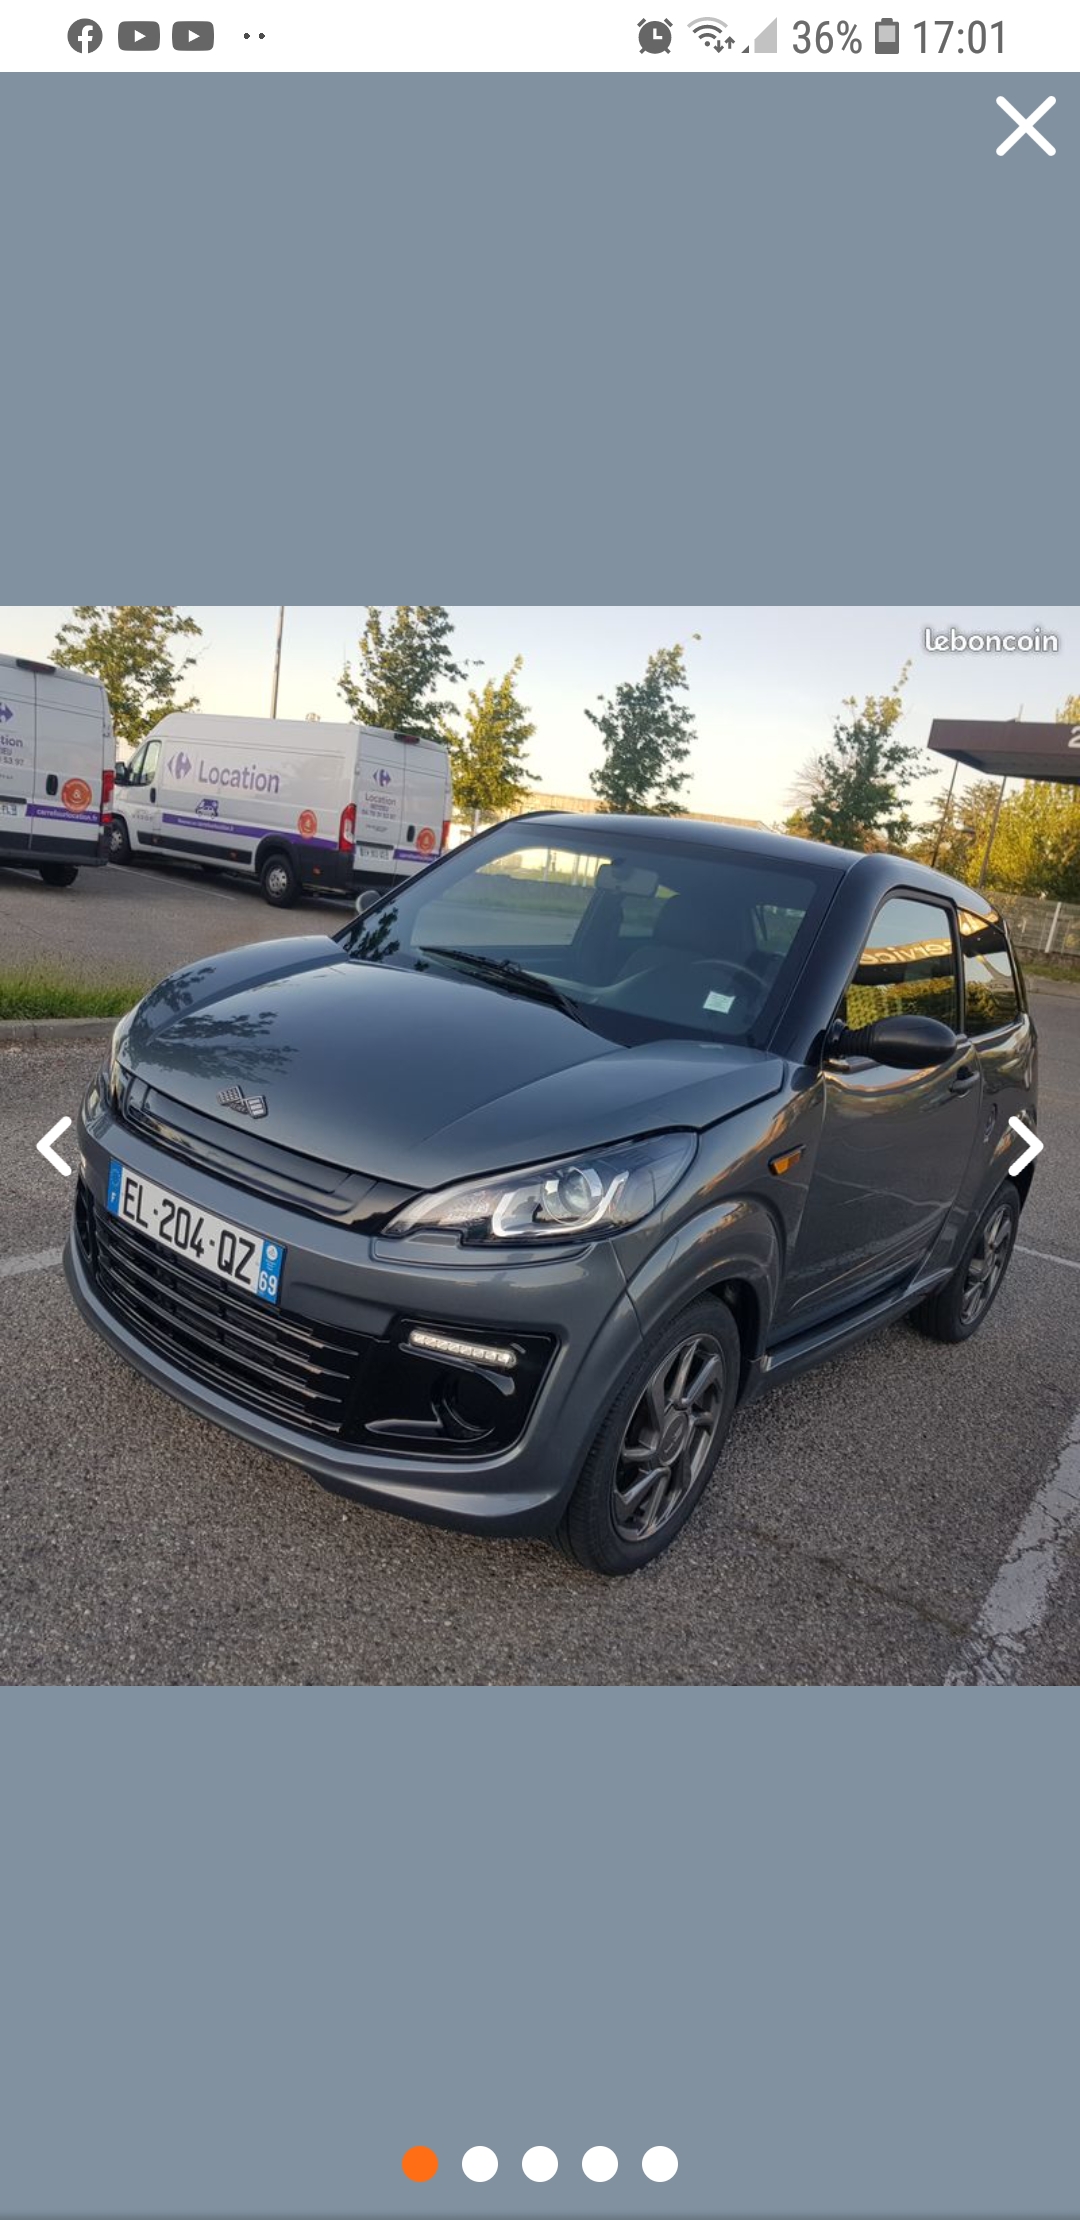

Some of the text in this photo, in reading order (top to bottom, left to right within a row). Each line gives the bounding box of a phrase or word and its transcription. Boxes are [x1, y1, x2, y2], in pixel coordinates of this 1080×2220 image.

[793, 20, 862, 54] 36%
[914, 20, 1003, 54] 17:01
[198, 760, 280, 794] Location
[365, 792, 397, 807] Location
[258, 1270, 278, 1296] 69
